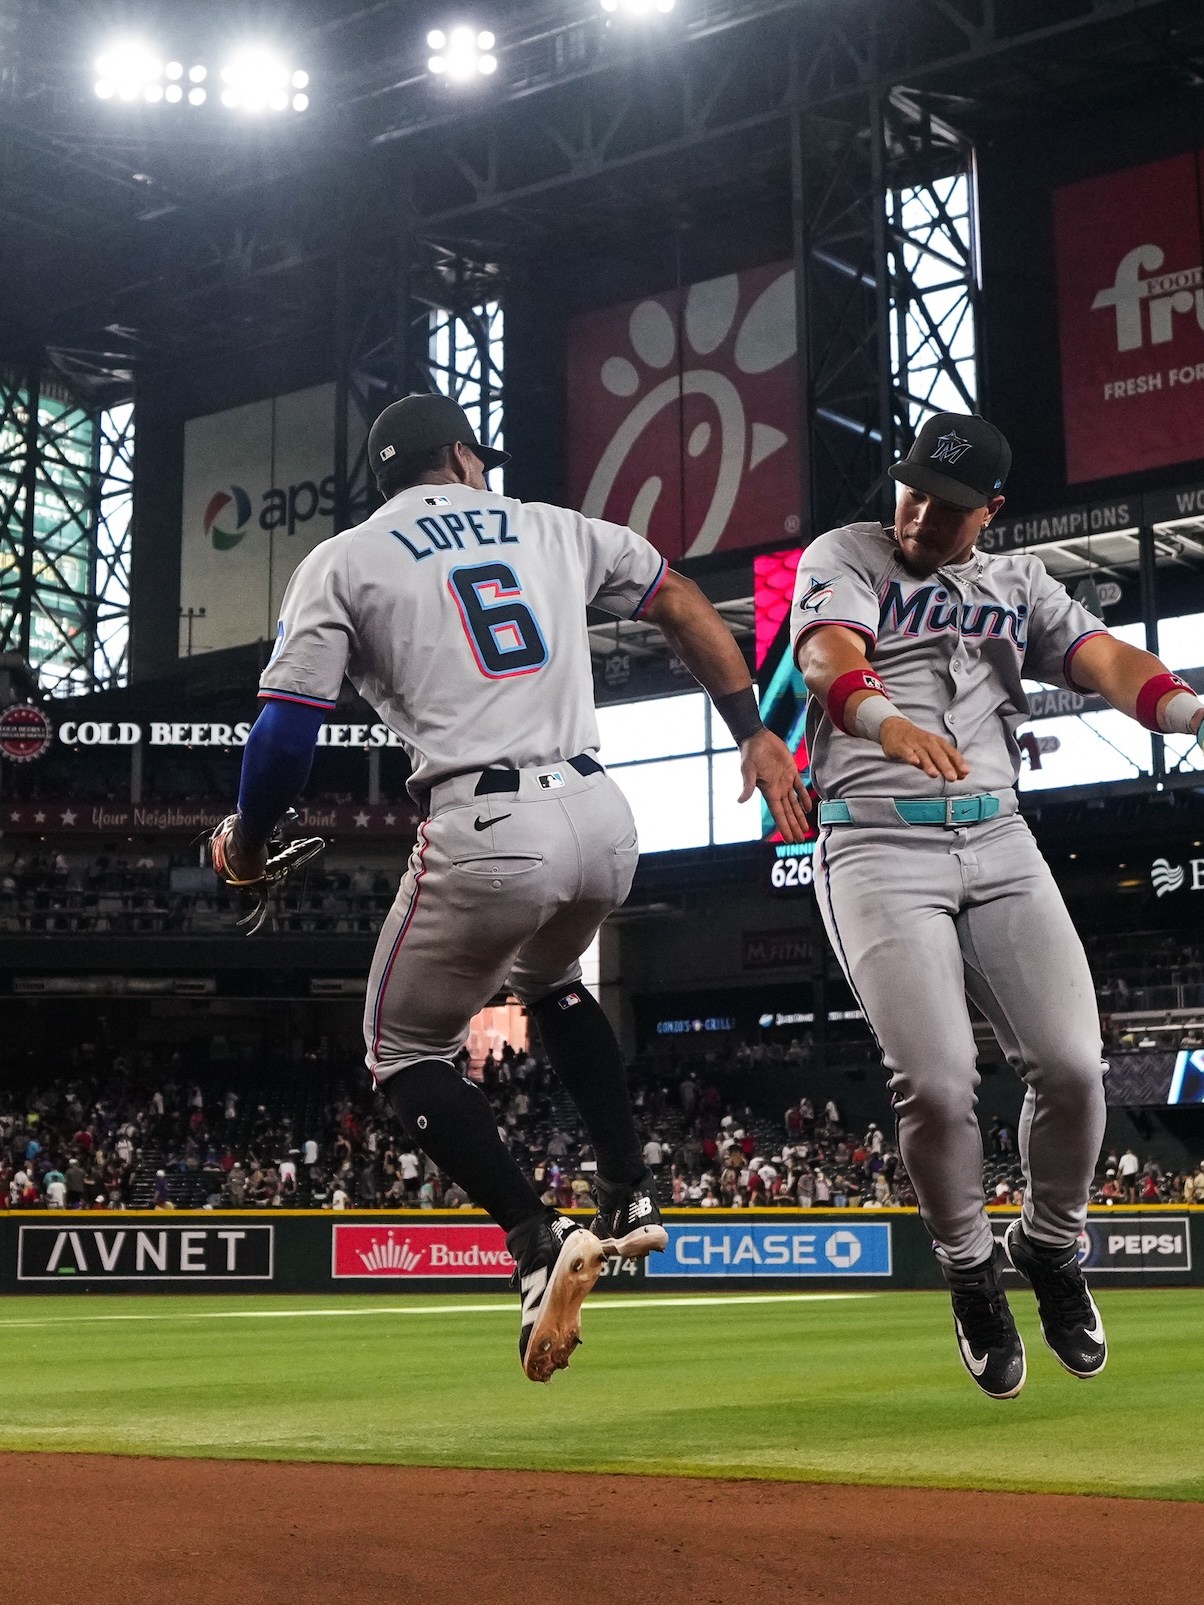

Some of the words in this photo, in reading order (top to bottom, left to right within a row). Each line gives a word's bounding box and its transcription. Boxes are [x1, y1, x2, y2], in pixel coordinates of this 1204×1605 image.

[1103, 373, 1163, 401] FRESH
[388, 507, 520, 563] LOPEZ
[1013, 504, 1131, 544] CHAMPIONS
[447, 560, 550, 680] 6
[878, 577, 1028, 652] Miami
[1031, 692, 1085, 718] CARD
[59, 721, 141, 746] COLD
[149, 721, 250, 747] BEERS
[91, 807, 128, 828] Your
[298, 808, 337, 829] Joint
[771, 856, 813, 888] 626
[45, 1231, 246, 1271] AVNET
[675, 1235, 818, 1265] CHASE
[1108, 1234, 1182, 1255] PEPSI
